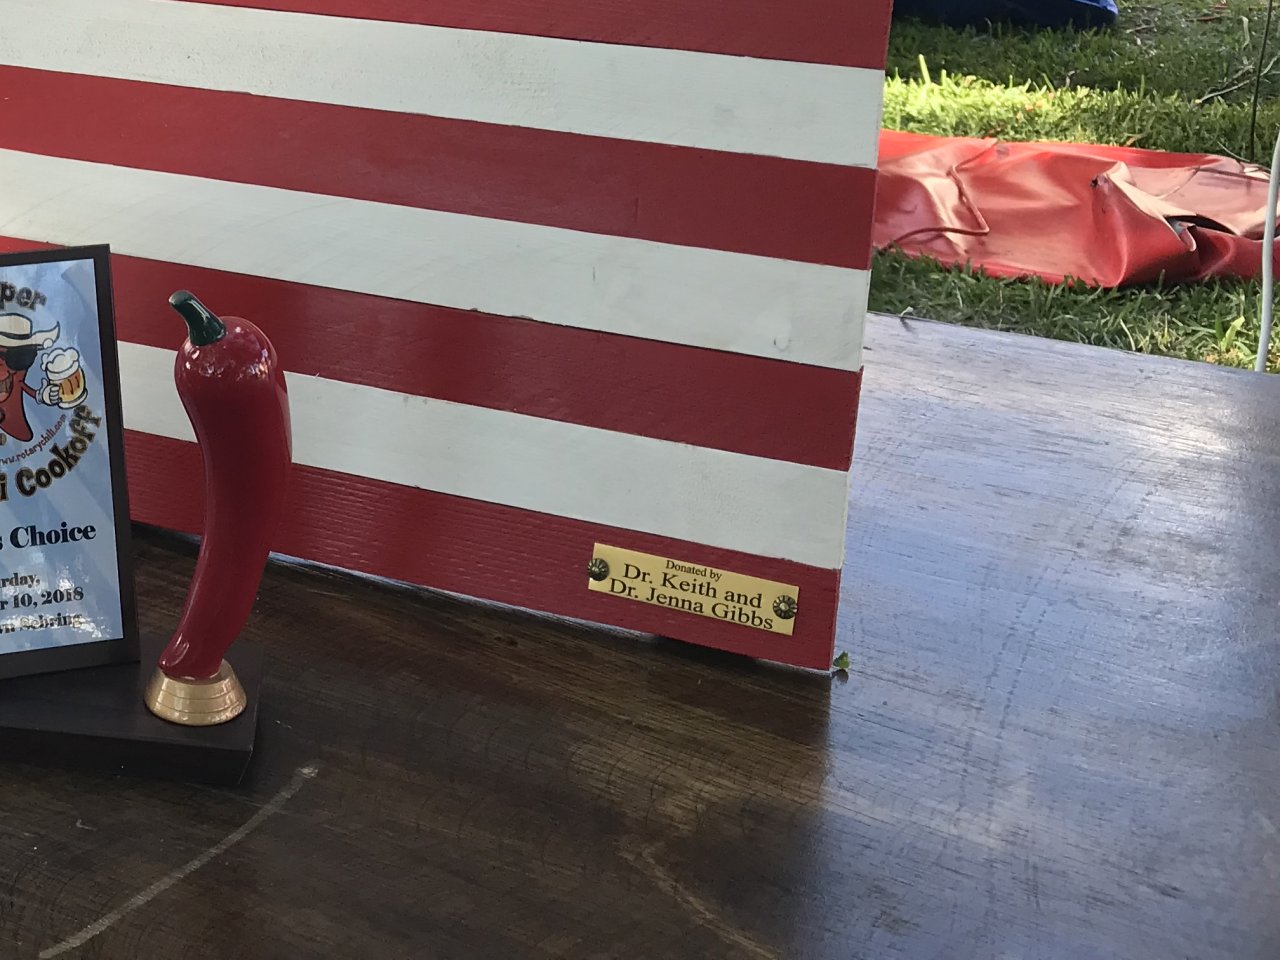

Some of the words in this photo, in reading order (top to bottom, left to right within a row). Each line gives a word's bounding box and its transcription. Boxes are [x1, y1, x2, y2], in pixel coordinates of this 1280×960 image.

[15, 404, 103, 497] Cookoff
[10, 521, 97, 550] Choice
[665, 559, 708, 578] Donated
[708, 568, 722, 582] by
[12, 593, 39, 609] 10,
[40, 586, 85, 606] 2018
[622, 563, 653, 584] Dr.
[661, 571, 718, 599] Keith
[723, 590, 763, 609] and
[608, 578, 639, 599] Dr.
[645, 588, 705, 614] Jenna
[711, 602, 774, 630] Gibbs
[19, 613, 84, 632] Sebring
